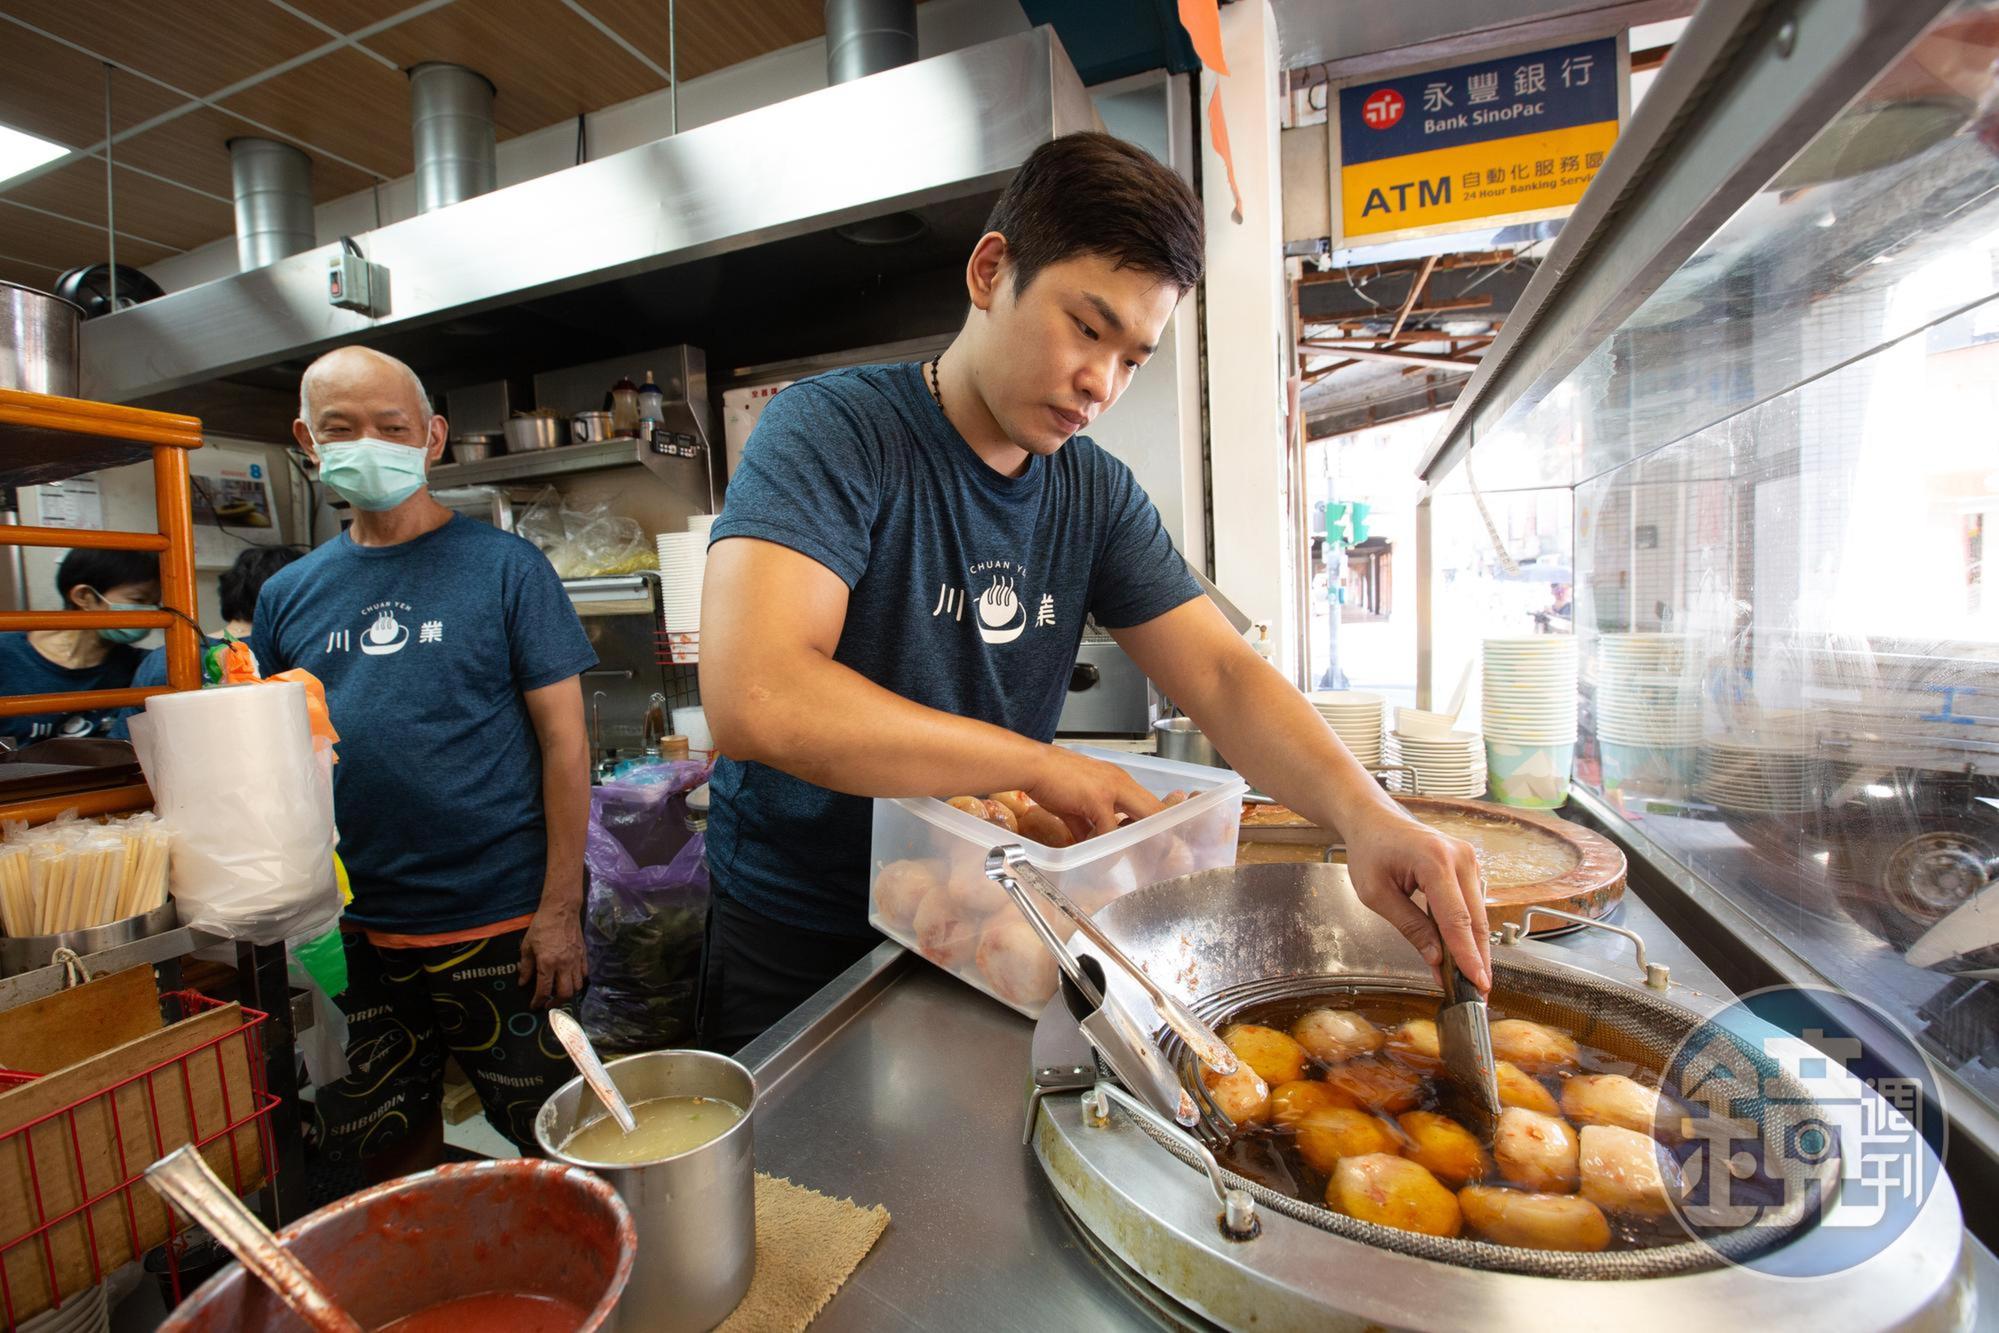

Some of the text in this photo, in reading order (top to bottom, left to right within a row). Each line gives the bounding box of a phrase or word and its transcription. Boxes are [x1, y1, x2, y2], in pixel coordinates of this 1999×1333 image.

[1423, 55, 1595, 112] 永豐銀行
[1424, 102, 1544, 134] Bank SinoPac
[1463, 151, 1605, 189] 自動化服務區
[1361, 176, 1452, 218] ATM
[1464, 191, 1477, 202] 24
[1480, 187, 1506, 199] Hour
[1510, 179, 1557, 195] Banking
[970, 561, 1010, 574] CHUAN
[361, 601, 391, 615] CHUAN
[933, 583, 965, 622] 川
[326, 620, 443, 653] 川 業
[347, 1003, 394, 1025] ORDIN
[330, 1091, 406, 1136] SHIBORDIN
